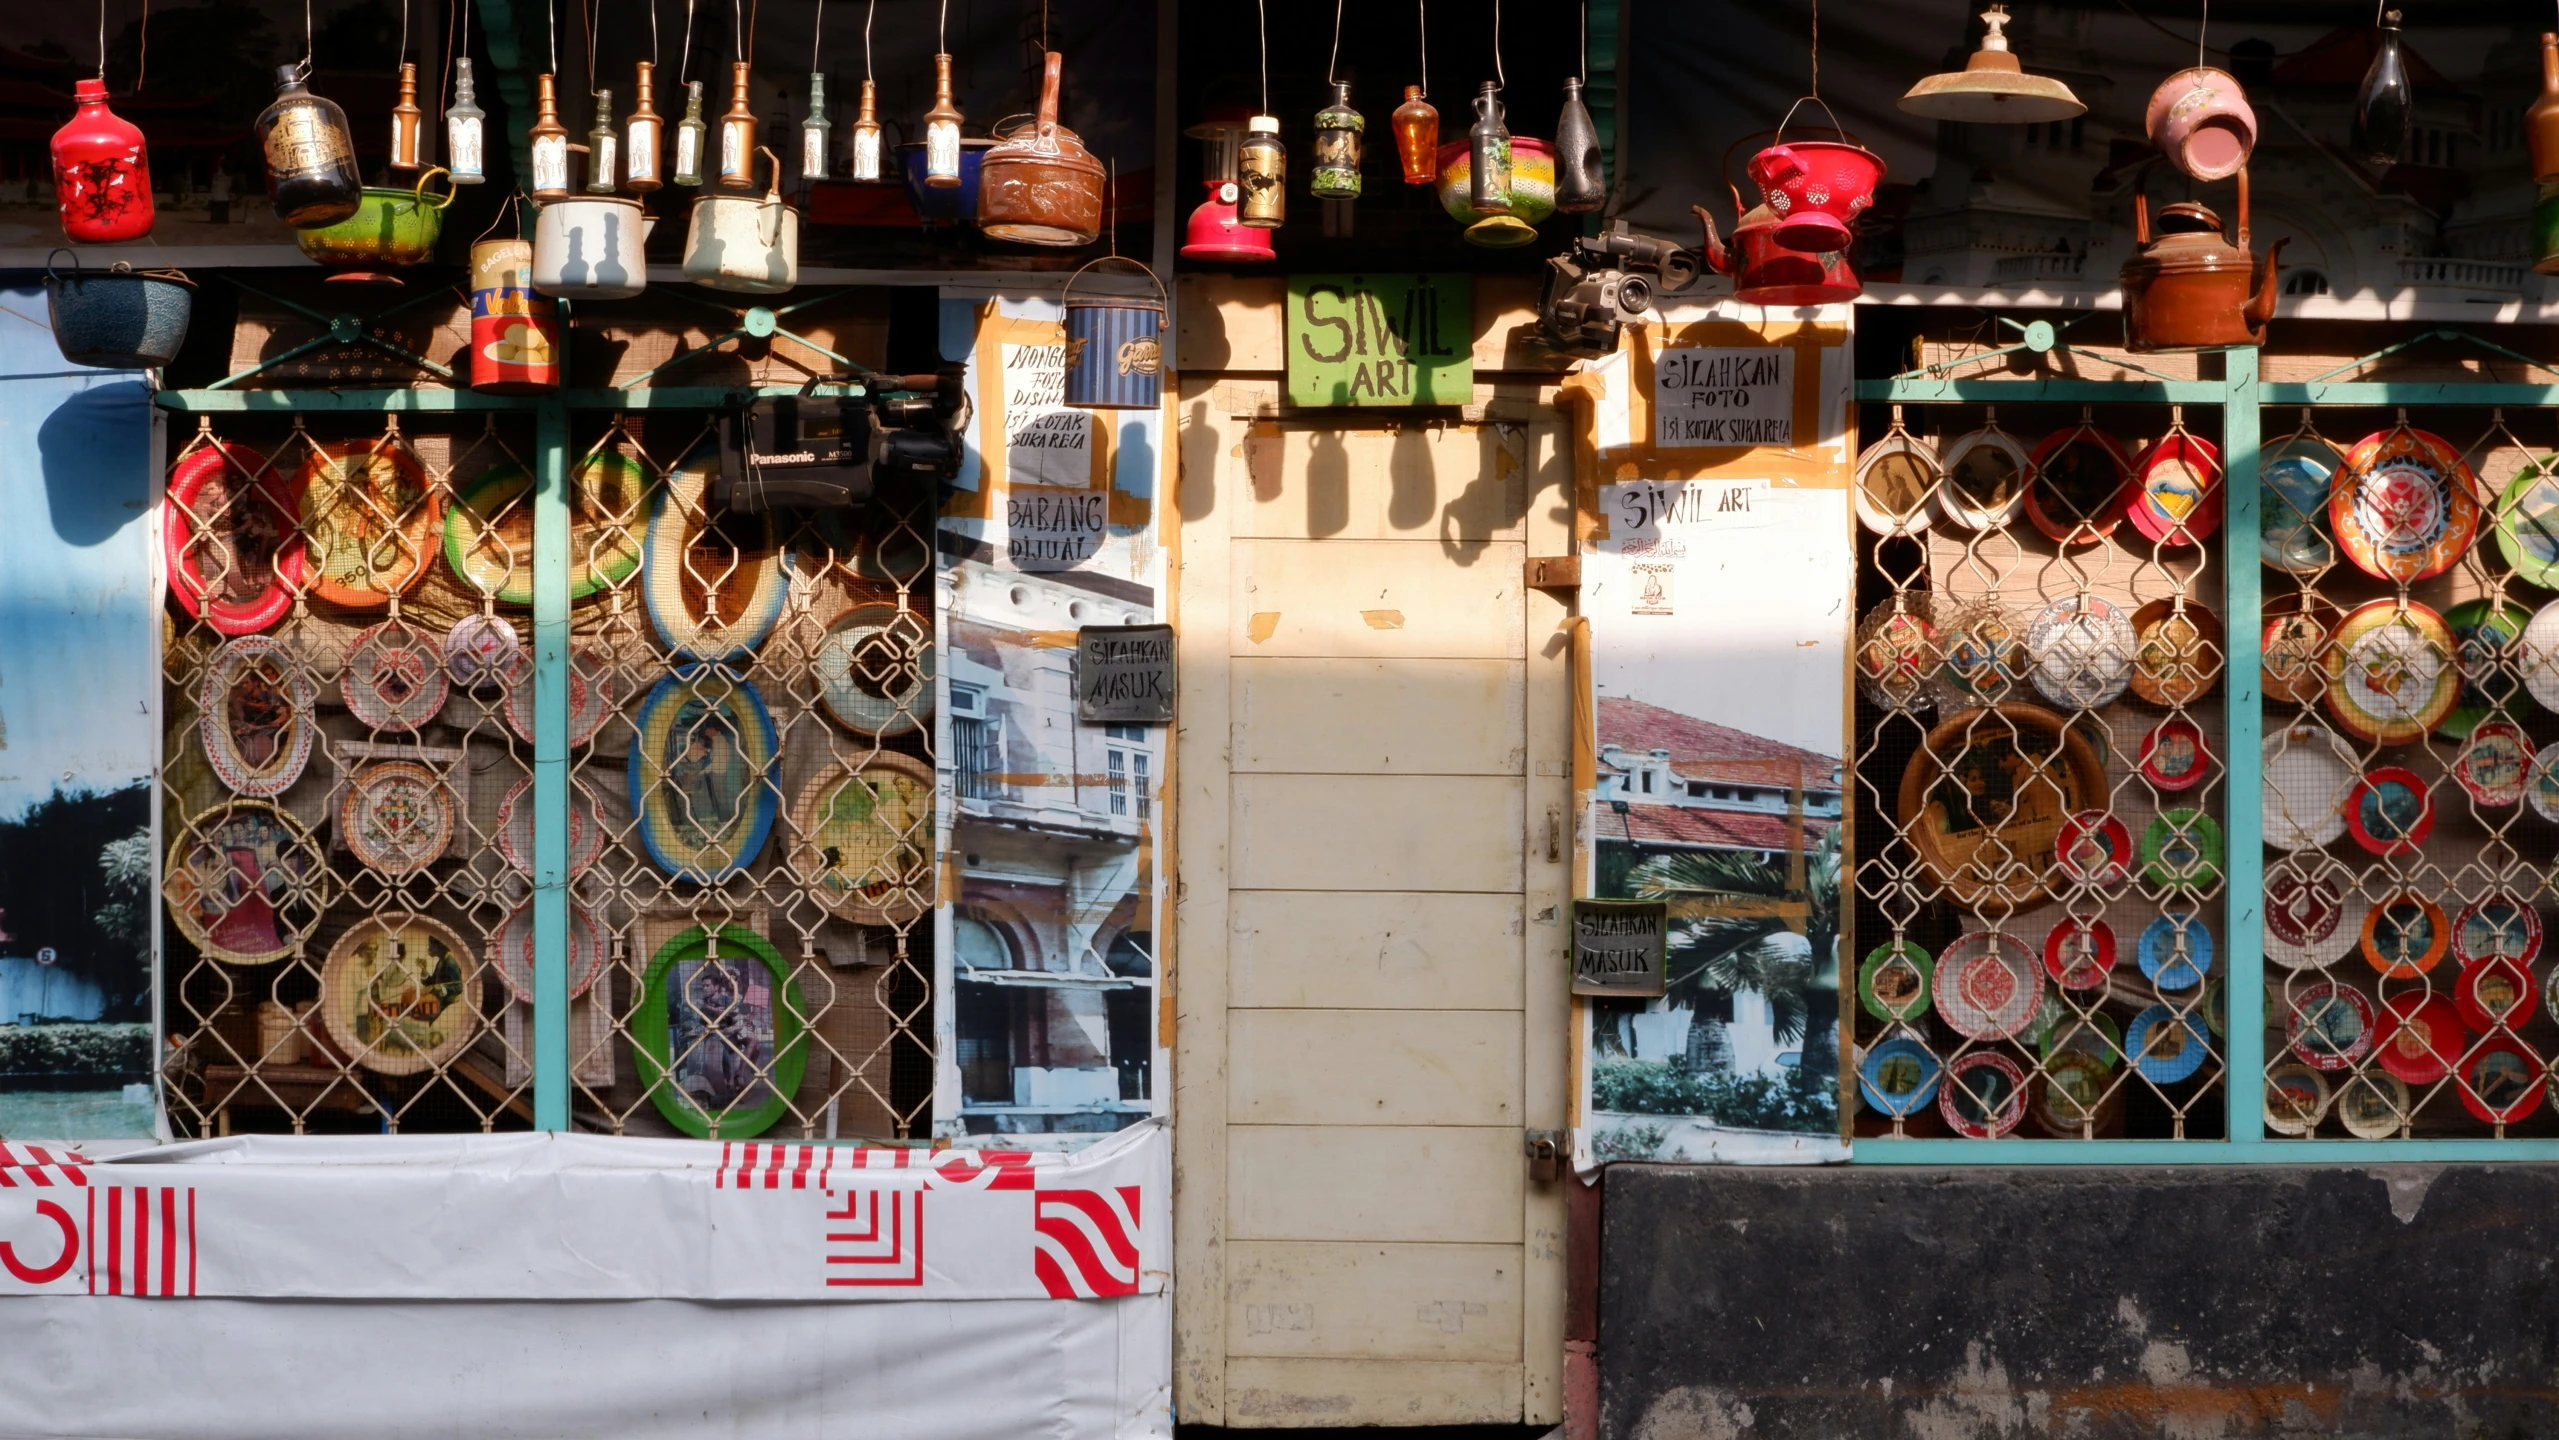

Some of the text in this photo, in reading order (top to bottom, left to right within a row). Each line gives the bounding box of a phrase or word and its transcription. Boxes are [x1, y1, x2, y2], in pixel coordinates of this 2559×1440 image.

[480, 245, 532, 273] BAGELEN
[1302, 276, 1453, 363] SIWIL
[1350, 359, 1416, 397] ART
[1661, 354, 1780, 389] SILAHKAN
[1692, 388, 1750, 409] FOTO
[1032, 412, 1085, 431] KOTAK
[1685, 419, 1726, 442] KOTAK
[1728, 418, 1790, 443] SUKARELA
[750, 451, 816, 465] Panasonic
[828, 450, 853, 459] M3500
[1007, 495, 1103, 533] BARANG
[1621, 483, 1752, 529] SIWIL ART
[1010, 535, 1092, 561] DIJUAL
[335, 565, 366, 588] 350
[1090, 637, 1170, 666] SILAHKAN
[1088, 670, 1165, 706] MASUK
[1580, 908, 1657, 937] SILAHKAN
[1578, 948, 1649, 975] MASUK
